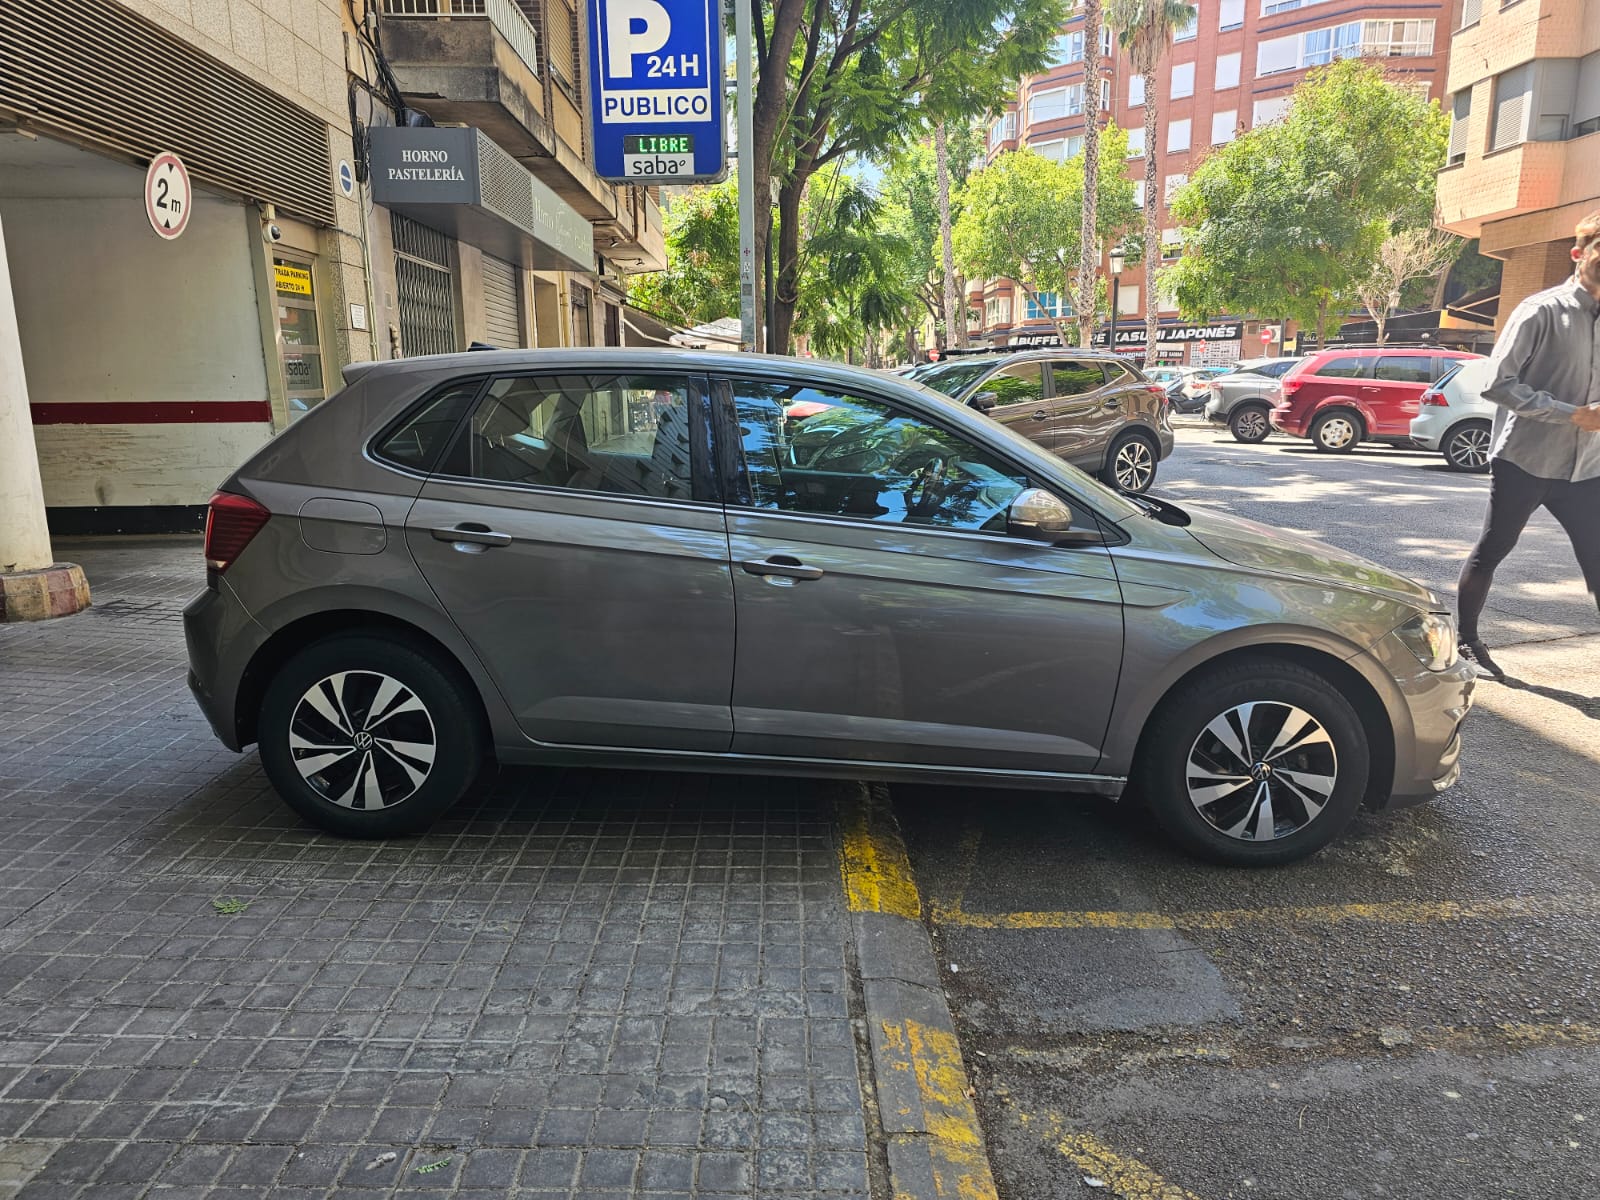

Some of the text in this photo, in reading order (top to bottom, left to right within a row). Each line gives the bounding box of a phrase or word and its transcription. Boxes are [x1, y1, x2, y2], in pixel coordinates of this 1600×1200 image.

[606, 0, 671, 78] P
[604, 95, 708, 117] PUBLICO
[639, 137, 689, 153] LIBRE
[402, 150, 448, 163] HORNO
[388, 165, 465, 181] PASTELERÍA
[156, 177, 182, 213] 2 m
[1166, 325, 1237, 340] JAPONÉS
